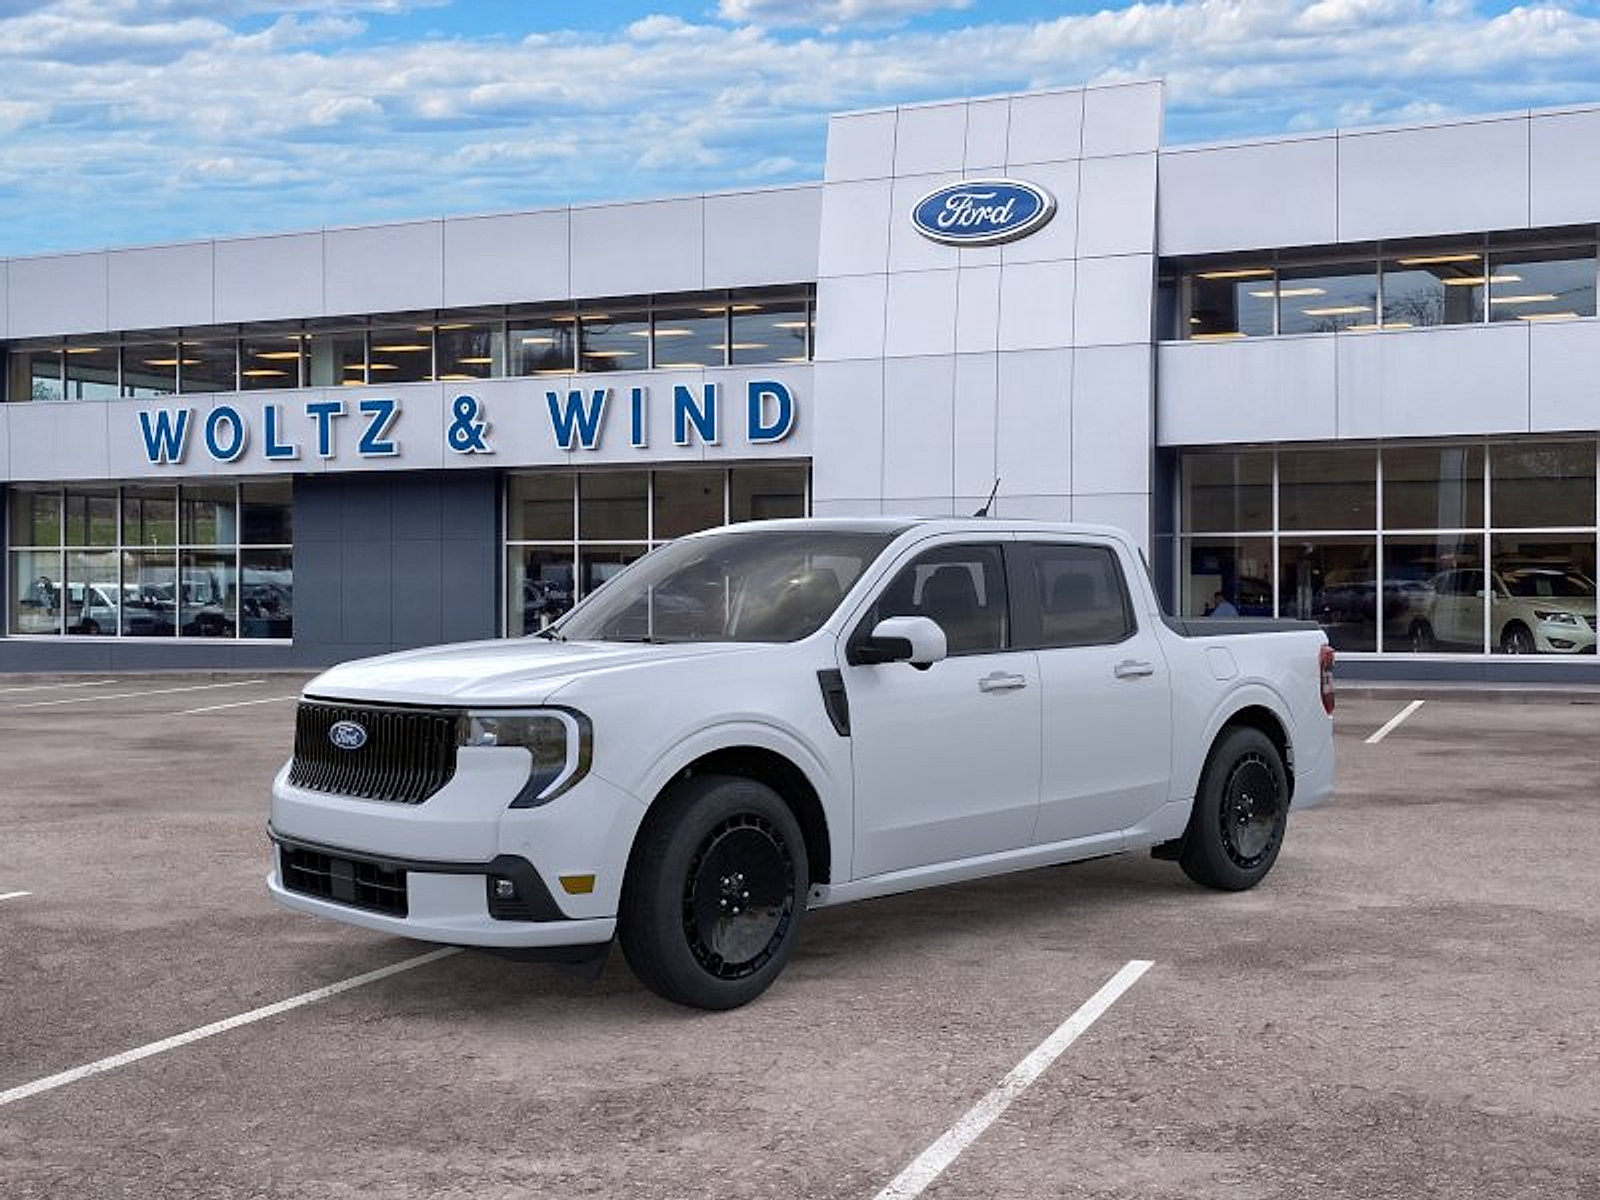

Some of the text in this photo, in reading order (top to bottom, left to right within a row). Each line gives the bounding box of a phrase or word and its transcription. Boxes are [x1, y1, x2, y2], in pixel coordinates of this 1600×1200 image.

[937, 192, 1015, 228] Ford
[138, 380, 796, 464] WOLTZ & WIND
[336, 726, 359, 745] Ford
